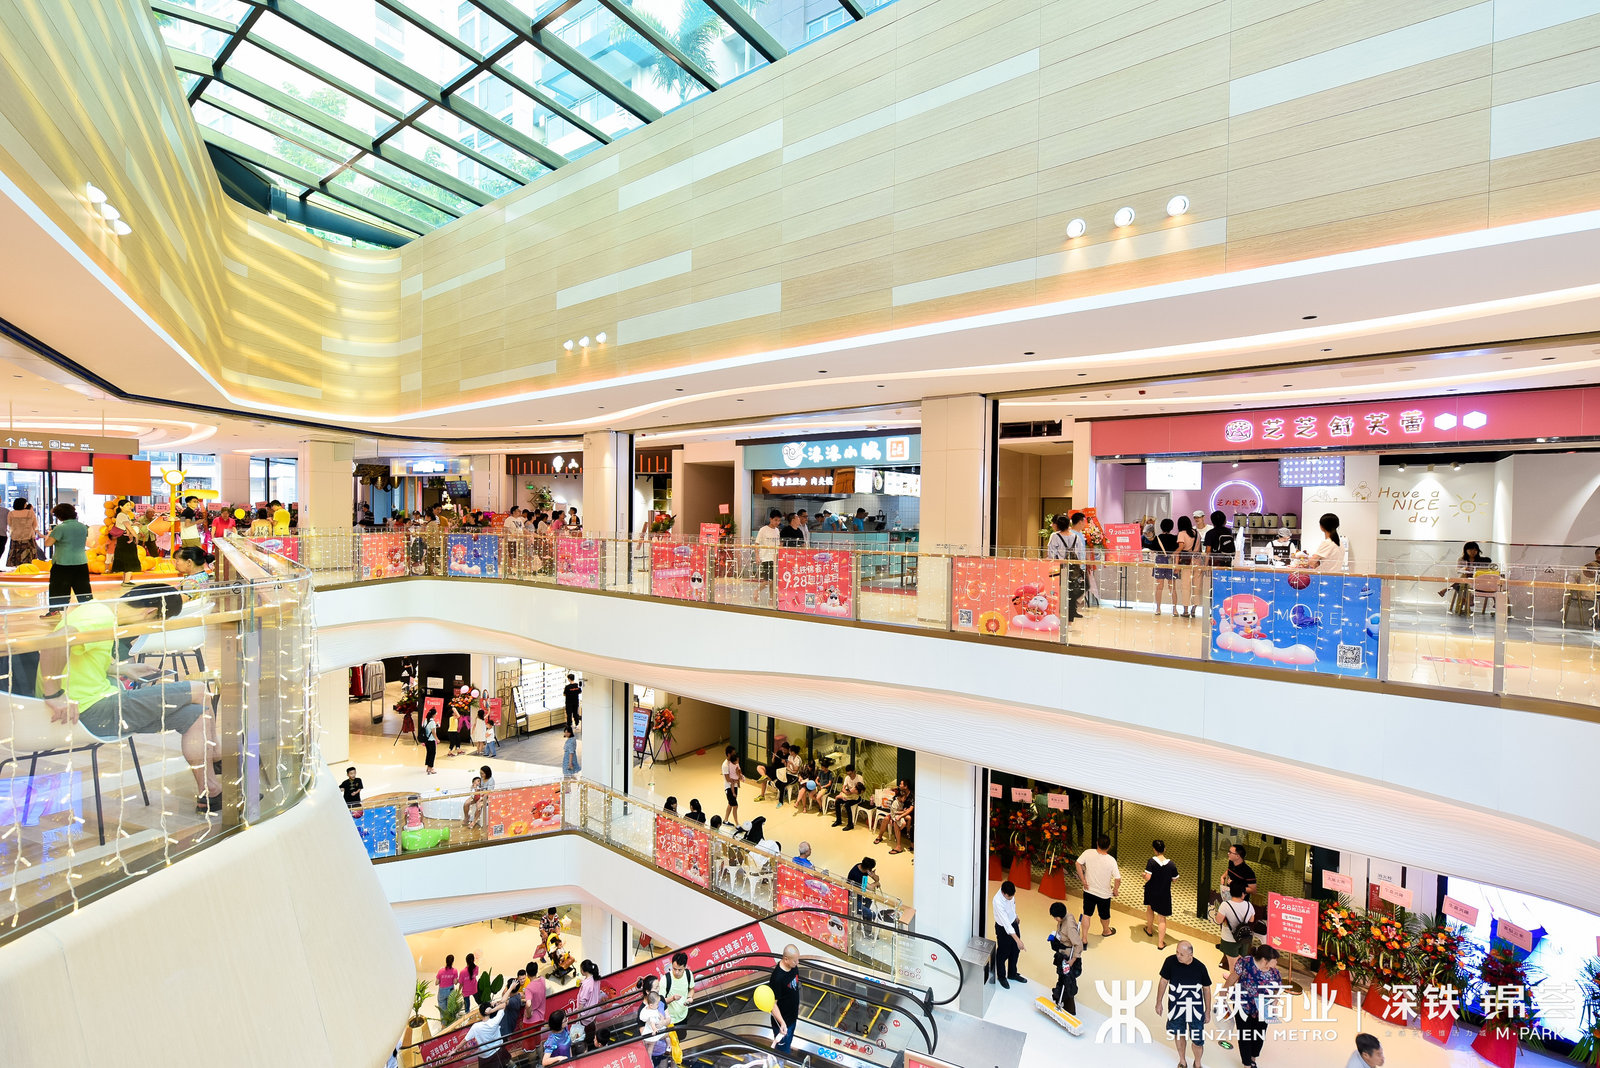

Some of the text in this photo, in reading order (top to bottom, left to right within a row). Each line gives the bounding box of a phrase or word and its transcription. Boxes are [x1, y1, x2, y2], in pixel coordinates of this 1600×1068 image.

[1262, 409, 1425, 440] 芝芝舒芙蕾
[1378, 487, 1440, 498] Have a
[1392, 498, 1440, 511] NICE
[1408, 512, 1440, 528] day
[782, 571, 808, 590] 9.28
[1273, 899, 1291, 910] 9.28
[855, 1021, 869, 1035] L3
